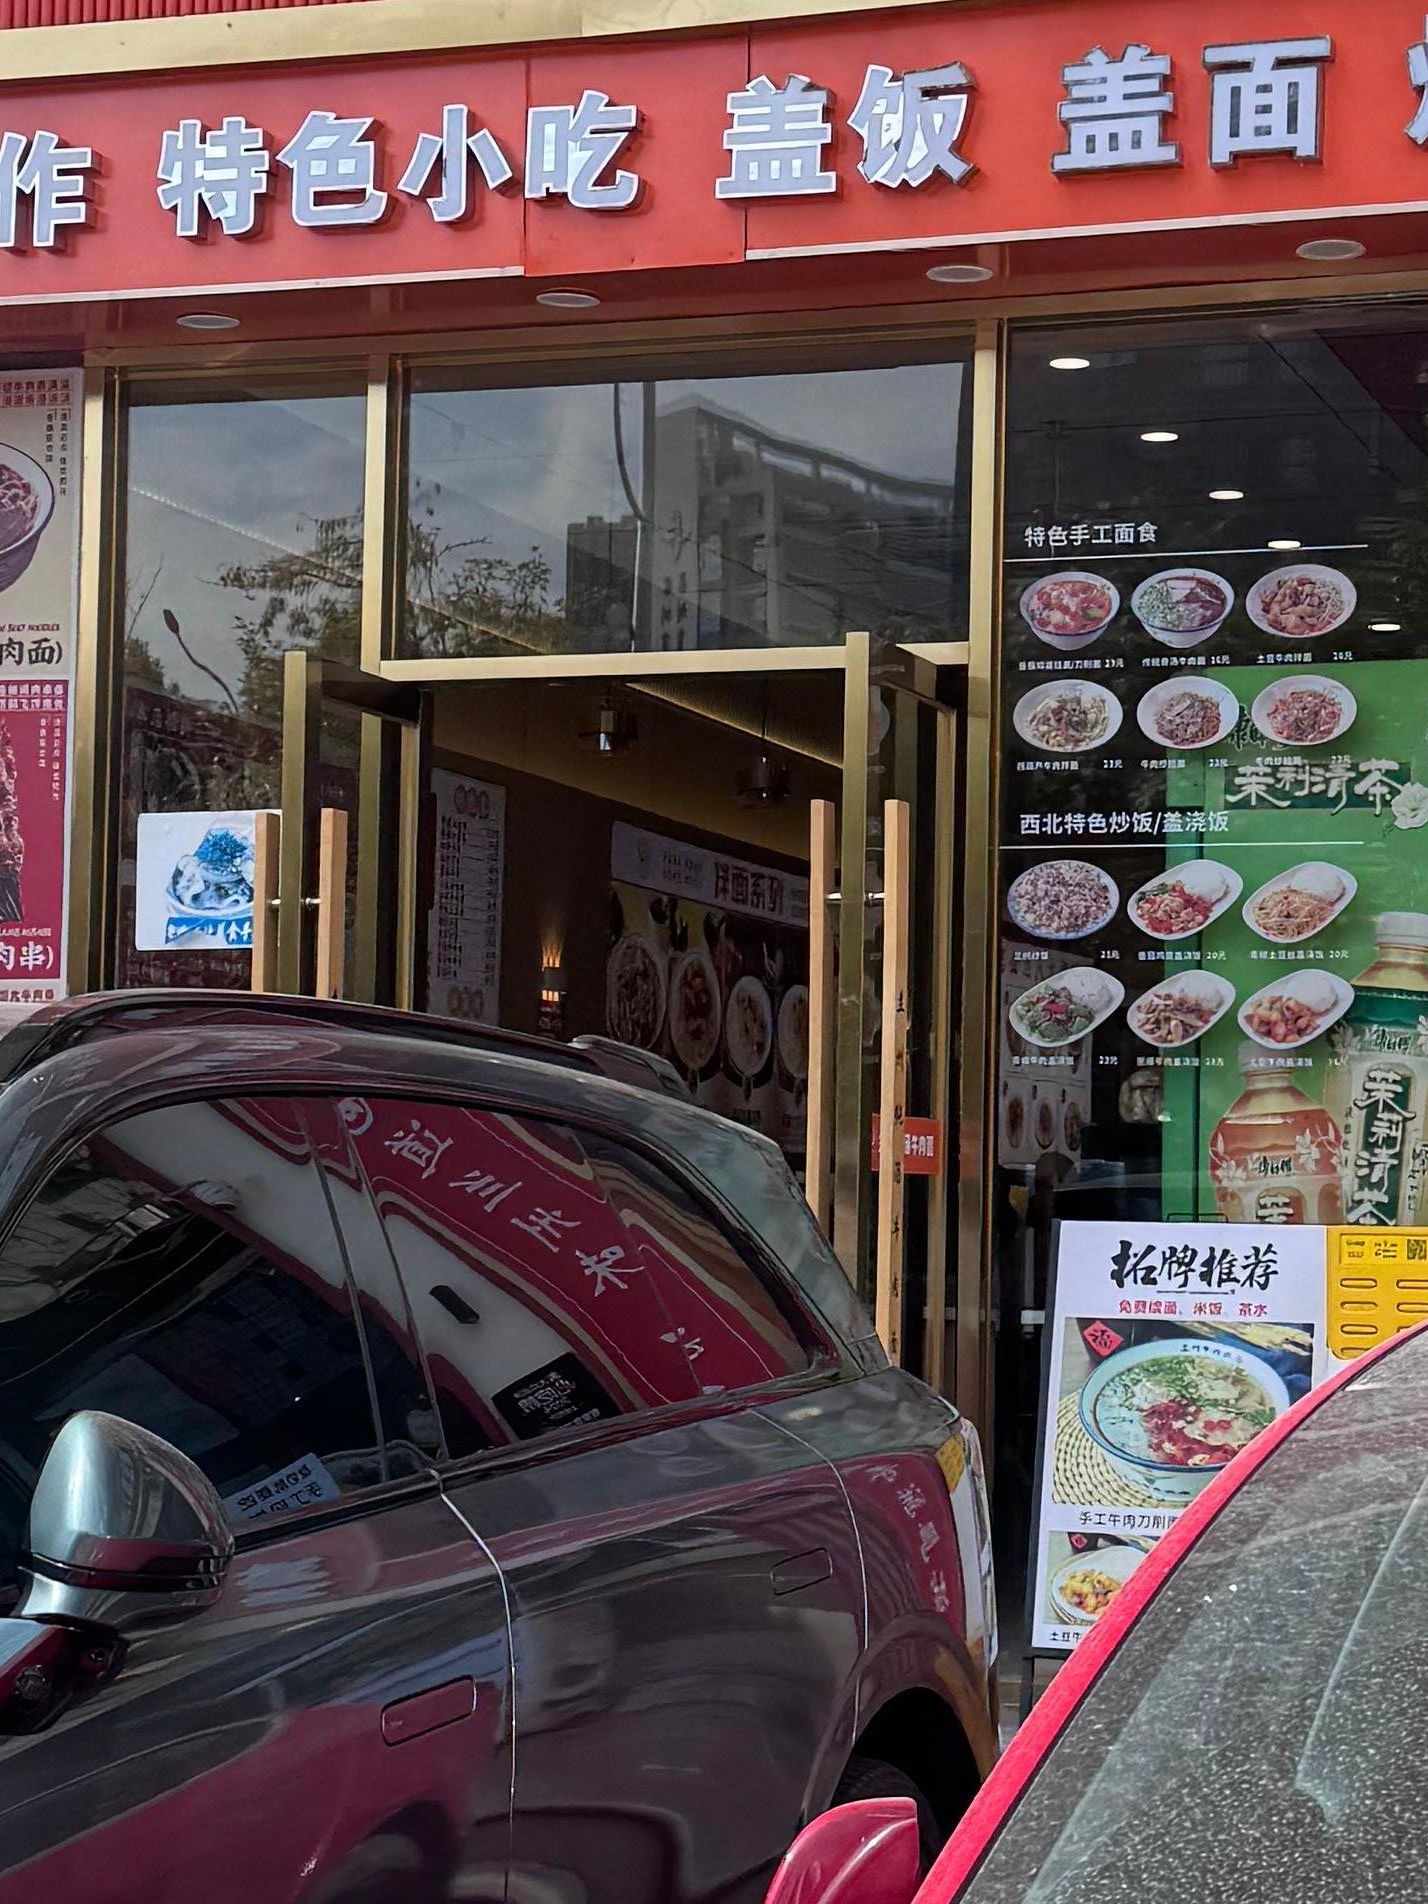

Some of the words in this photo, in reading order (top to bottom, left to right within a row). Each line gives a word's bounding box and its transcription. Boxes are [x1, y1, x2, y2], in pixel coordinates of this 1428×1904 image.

[157, 88, 641, 238] 特色小吃
[714, 63, 976, 200] 盖饭
[1050, 35, 1333, 176] 盖面
[1024, 522, 1159, 548] 特色手工面食
[1225, 757, 1404, 816] 茉莉清茶
[1020, 810, 1230, 835] 西北特色炒饭/盖浇饭
[1109, 1239, 1279, 1291] 招牌推荐
